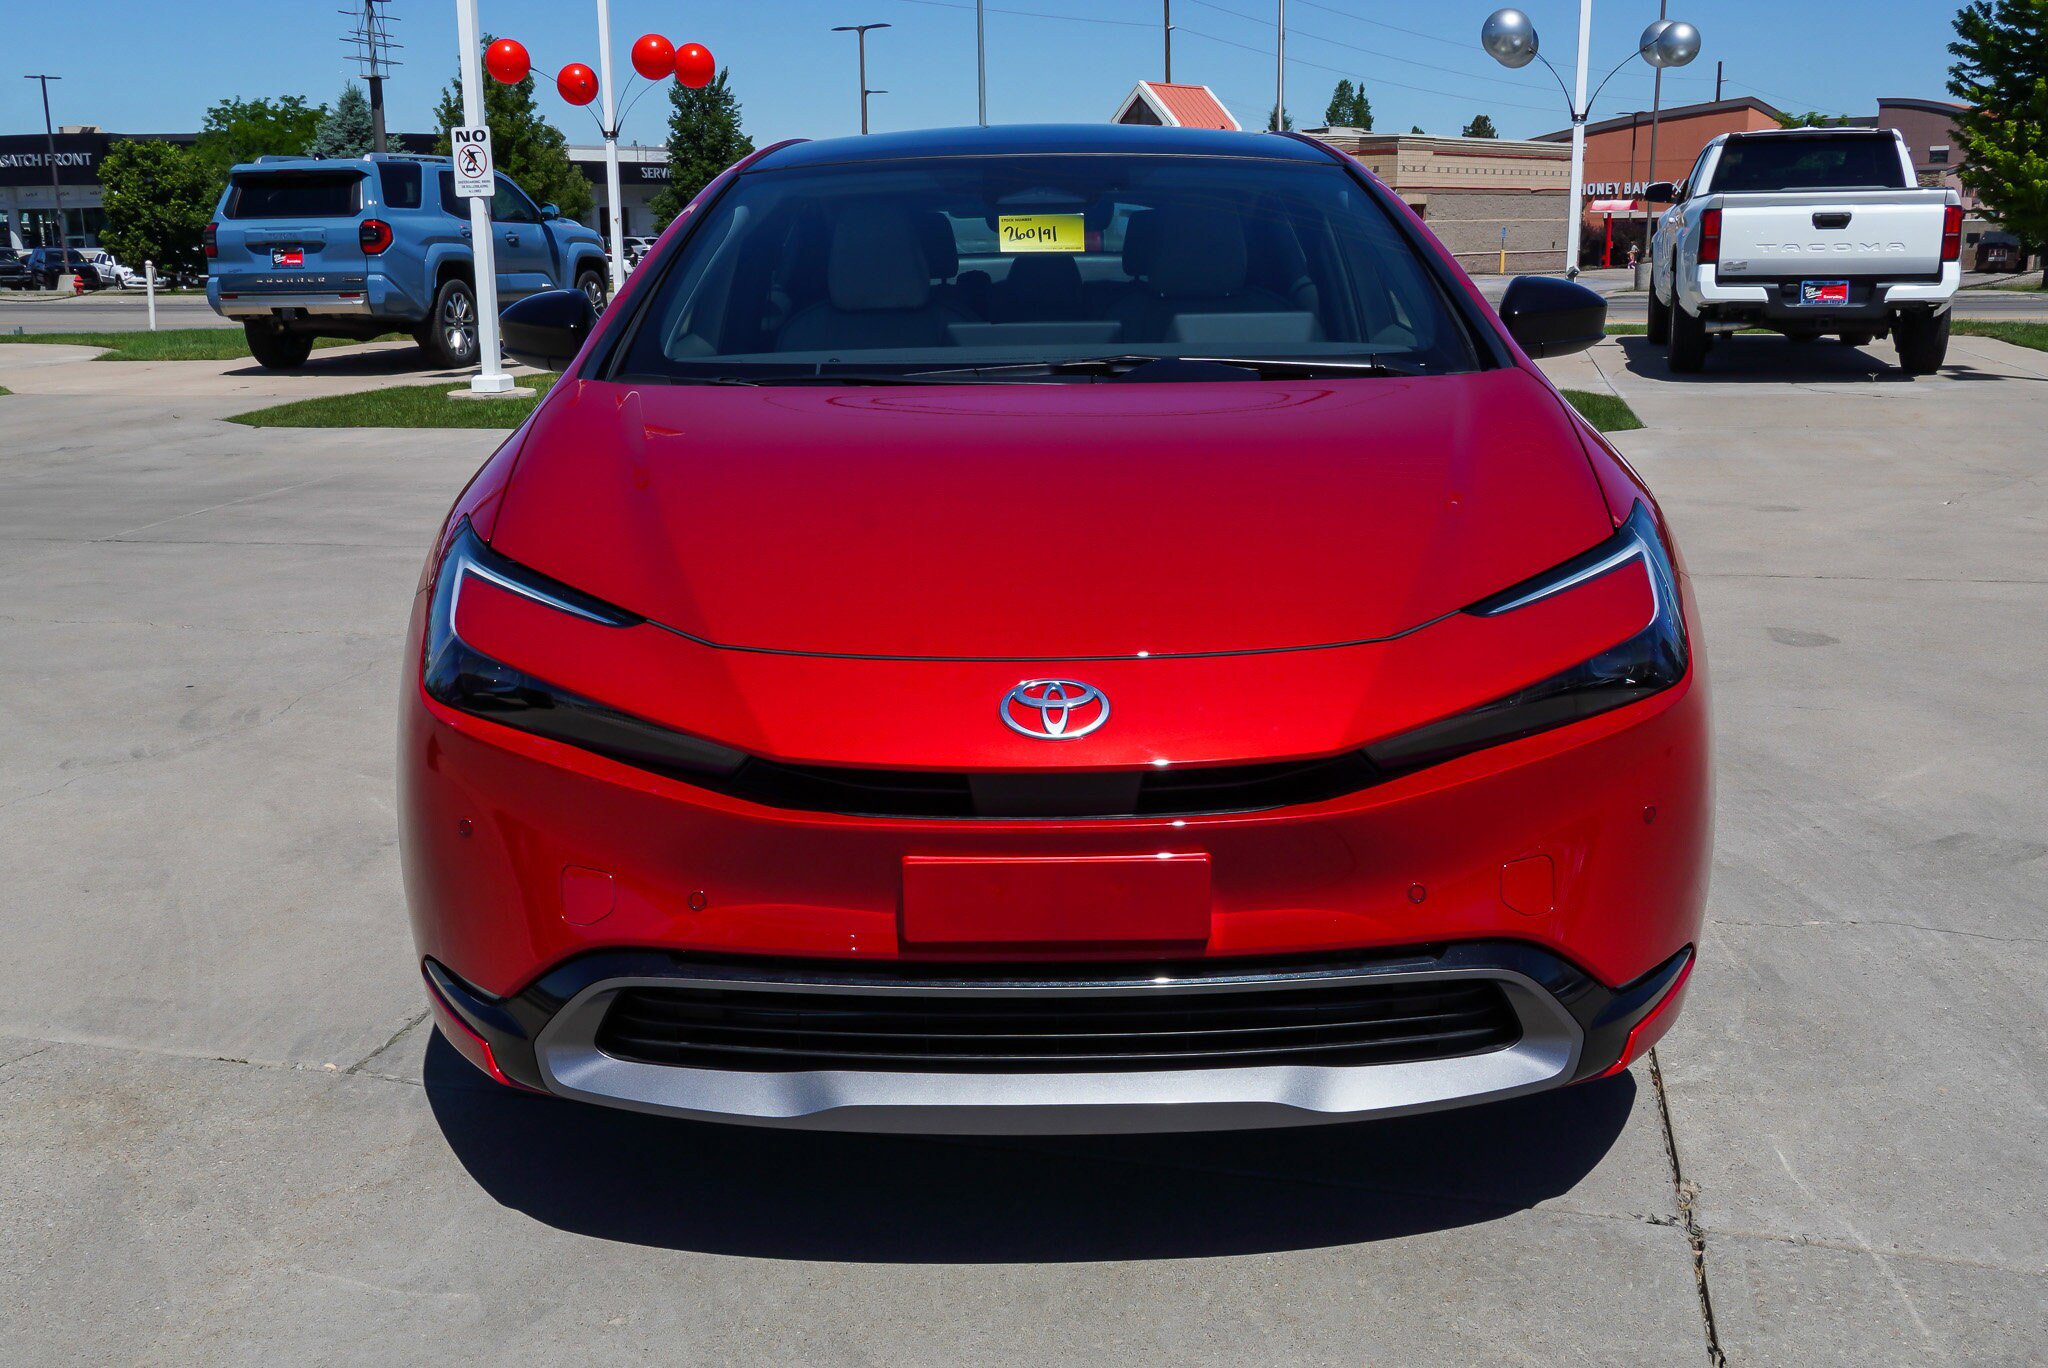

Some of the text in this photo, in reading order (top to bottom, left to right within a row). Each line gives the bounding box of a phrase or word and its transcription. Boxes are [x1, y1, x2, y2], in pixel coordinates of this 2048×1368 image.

[455, 130, 487, 143] NO
[0, 153, 92, 168] SATCH FRONT
[1004, 226, 1057, 242] 260191
[1756, 242, 1906, 253] TACOMA
